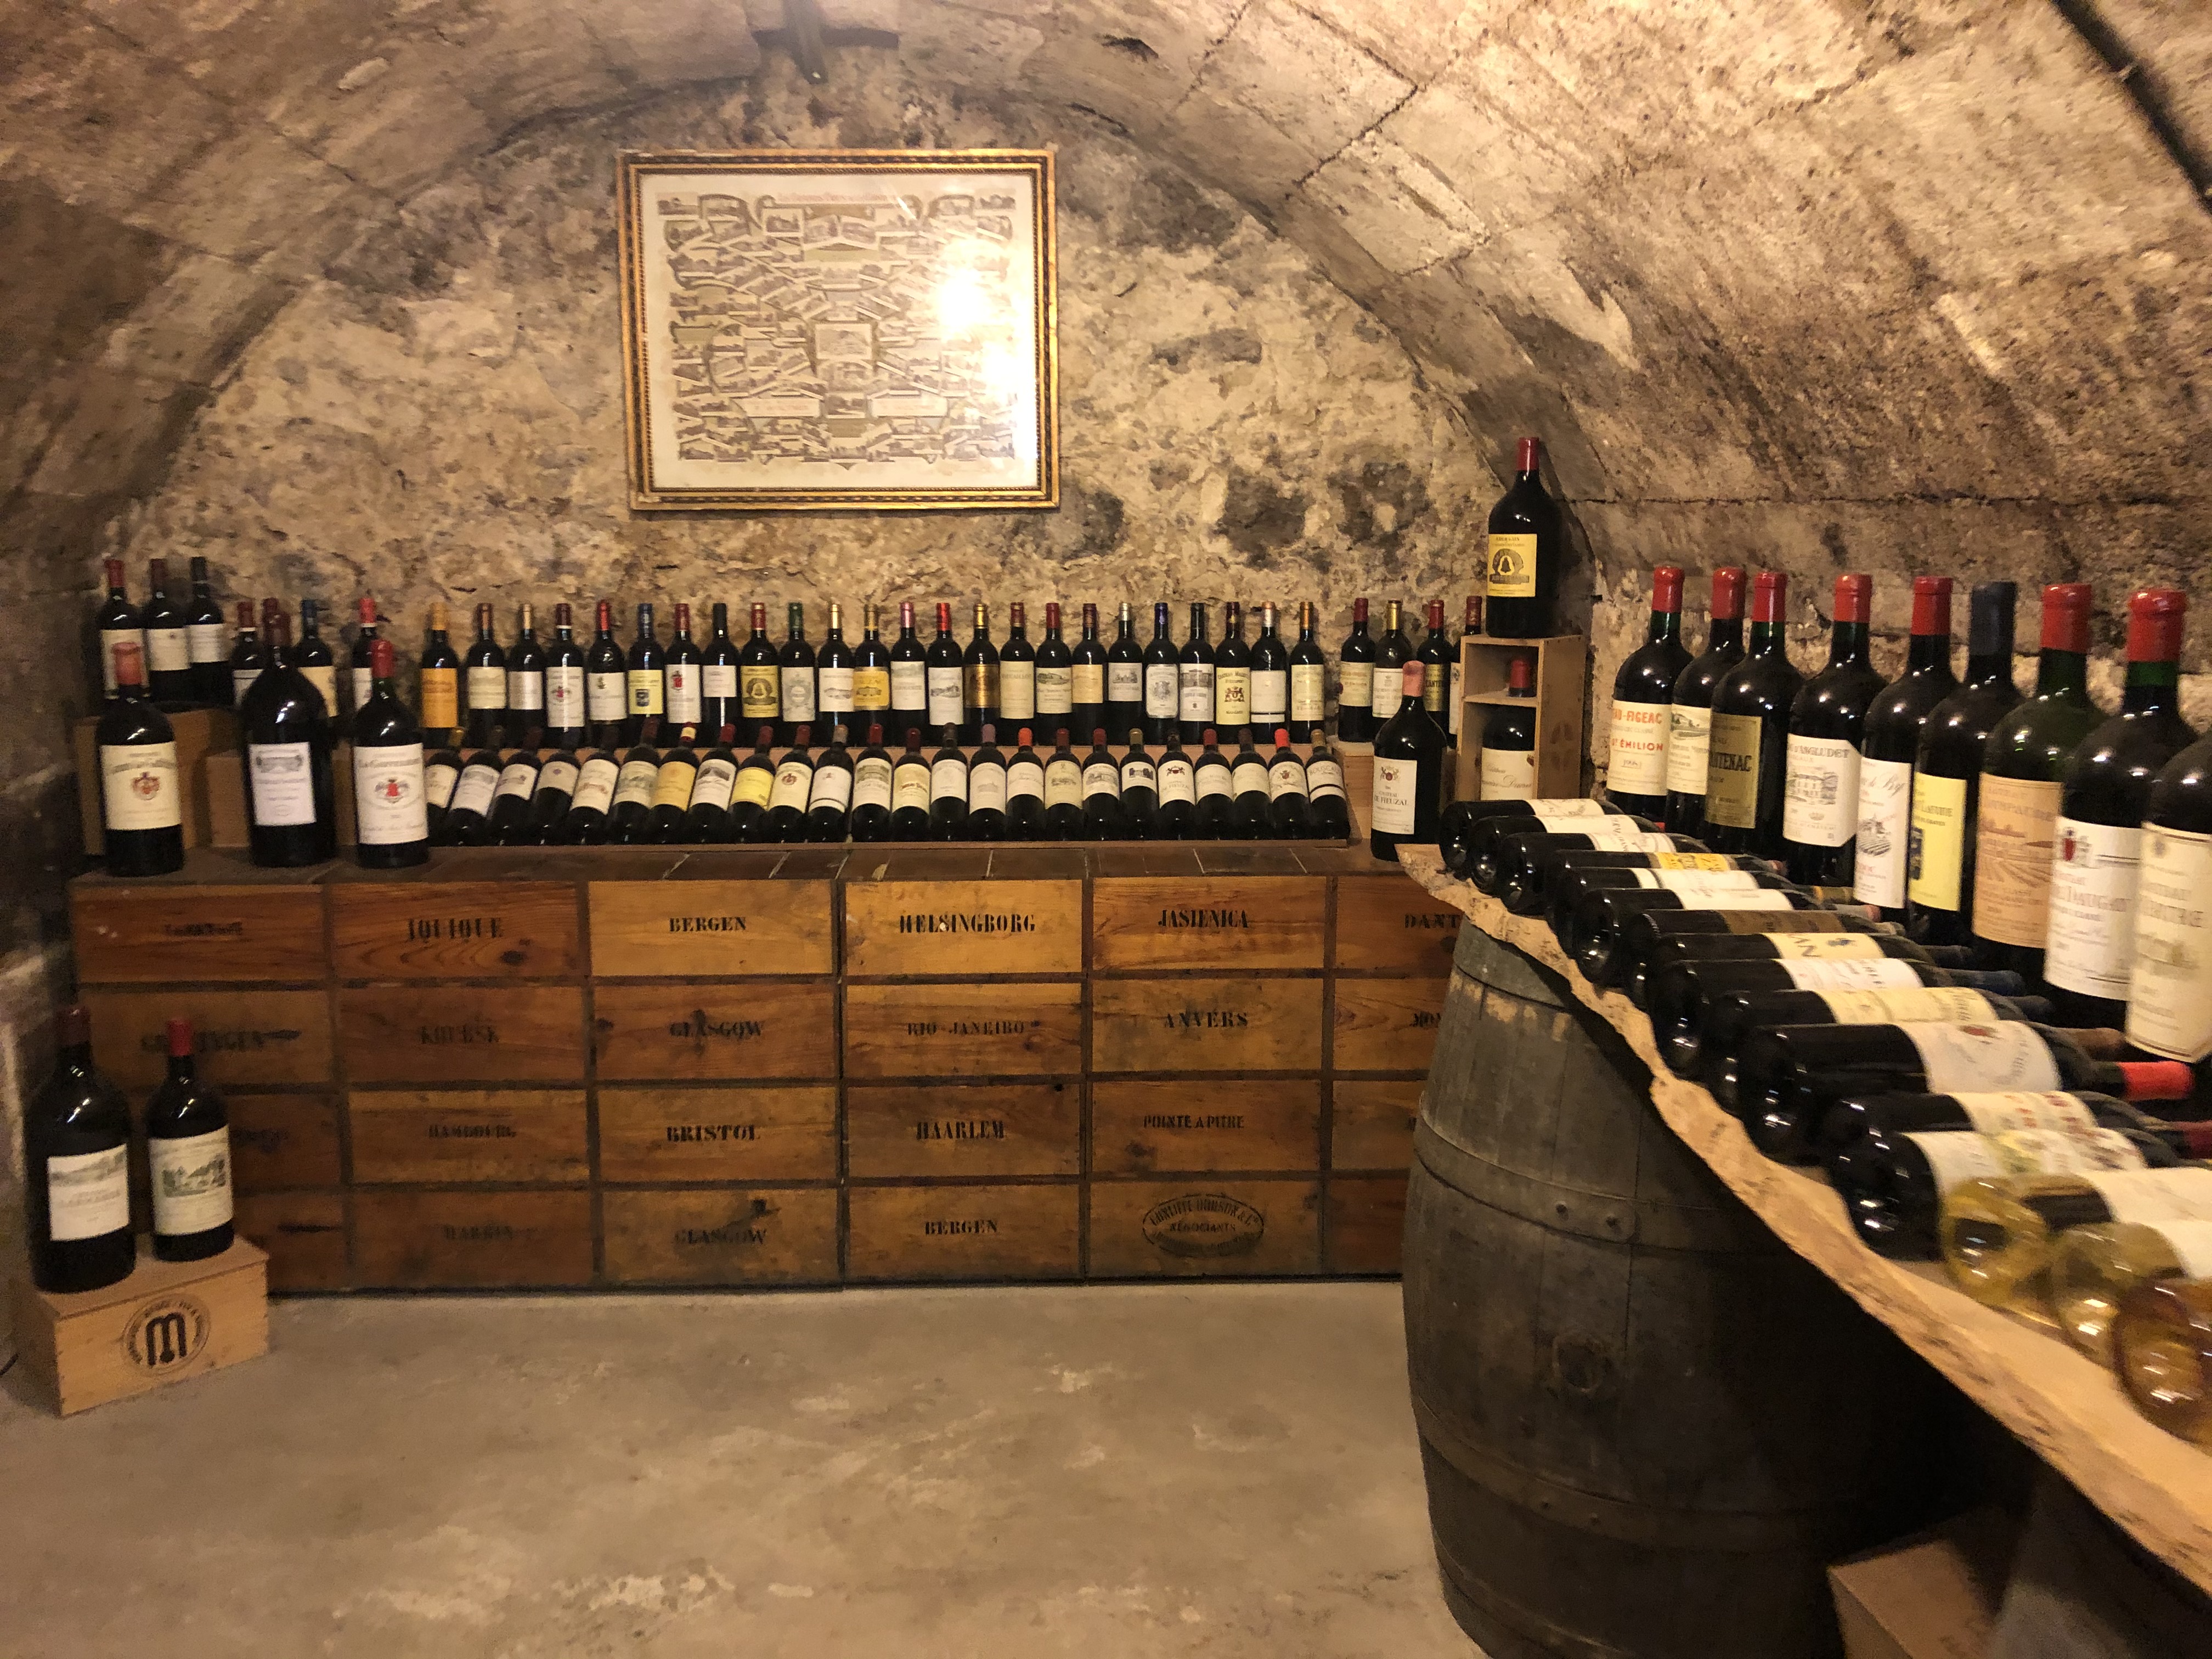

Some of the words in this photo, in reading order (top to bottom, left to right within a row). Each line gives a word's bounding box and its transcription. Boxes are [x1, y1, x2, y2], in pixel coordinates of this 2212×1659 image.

[669, 916, 747, 933] BERGEN
[899, 913, 1036, 934] HELSINGBORG
[1164, 1012, 1249, 1028] ANVERS
[666, 1124, 760, 1142] BRISTOL
[916, 1120, 1007, 1141] HAARLEM
[925, 1219, 998, 1236] BERGEN
